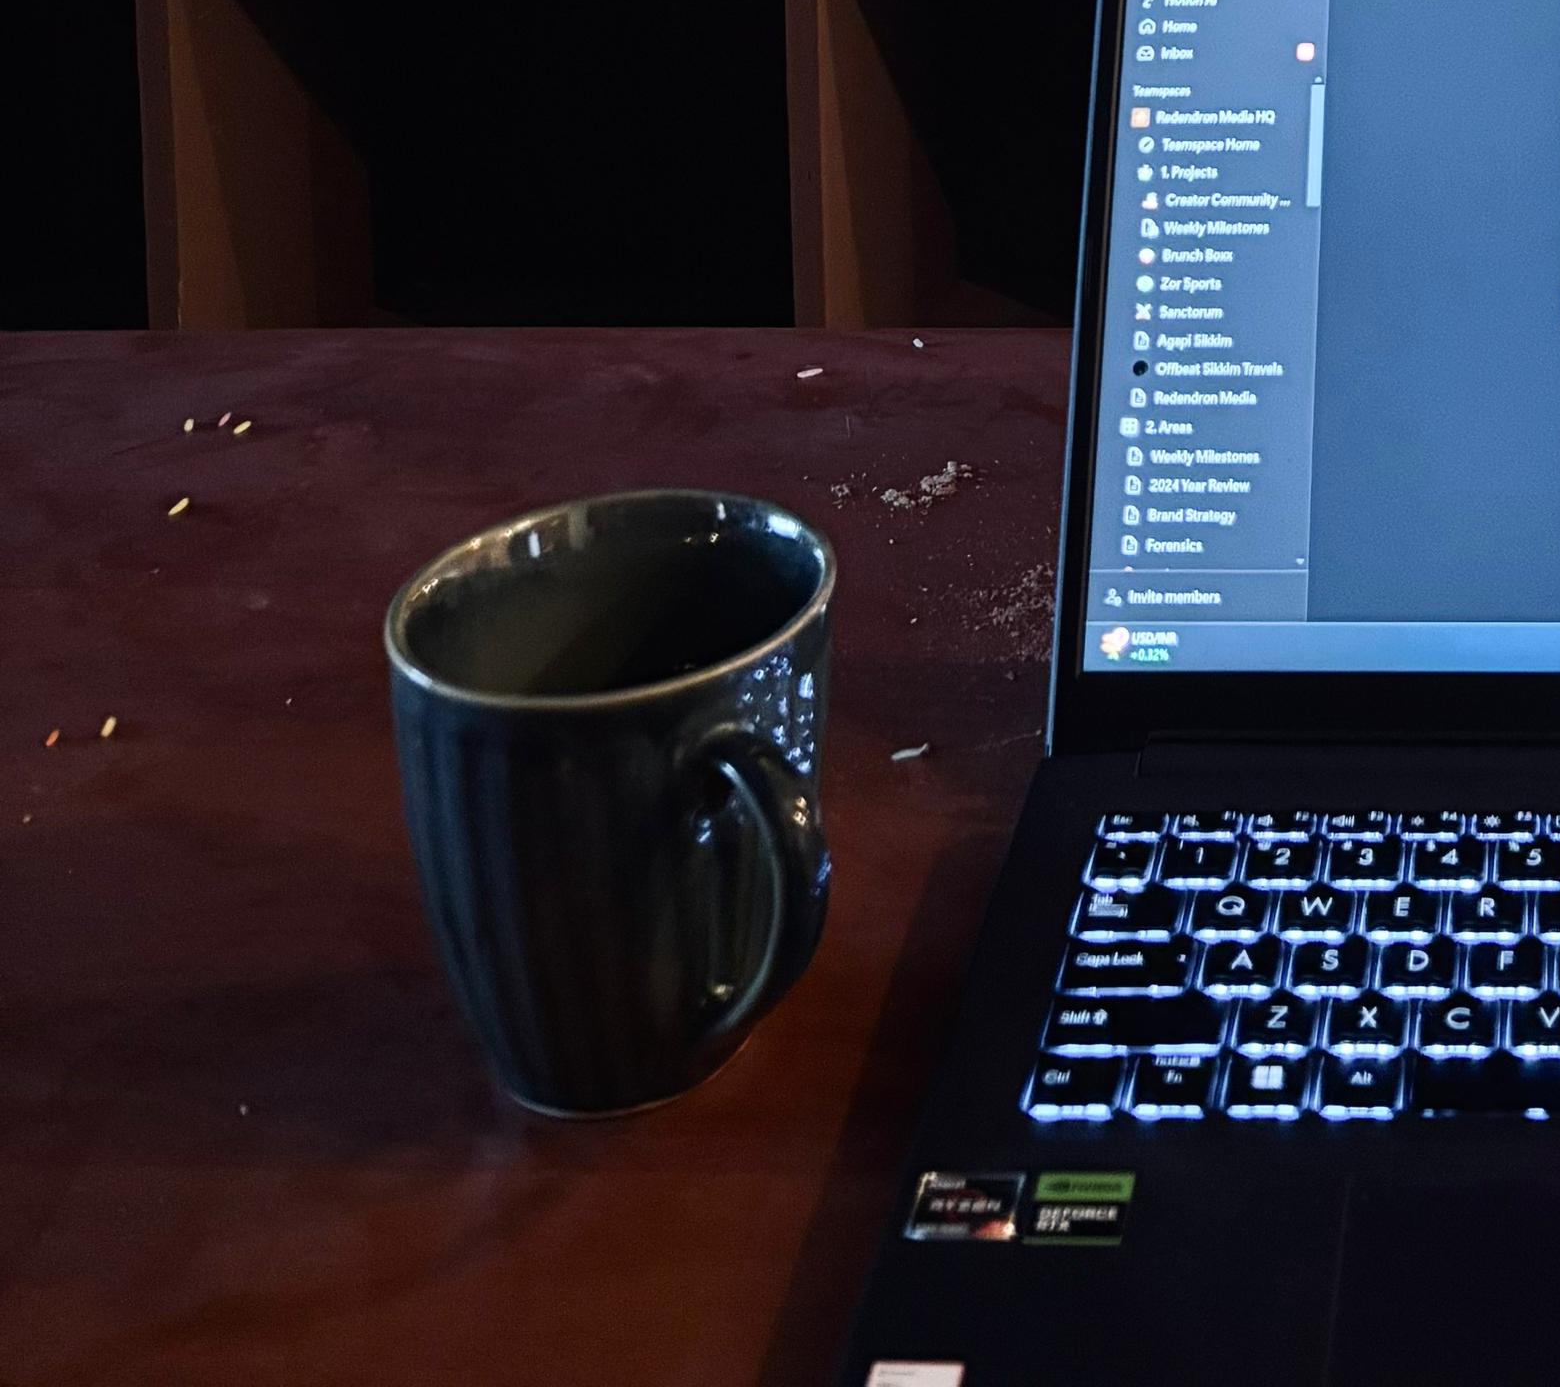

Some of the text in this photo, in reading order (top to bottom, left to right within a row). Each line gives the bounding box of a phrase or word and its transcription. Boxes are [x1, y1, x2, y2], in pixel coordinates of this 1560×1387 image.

[1161, 47, 1193, 60] Inbox
[1149, 479, 1250, 493] 2024 Year Review
[1147, 509, 1236, 526] Brand Strategy
[1145, 539, 1203, 553] Forensics
[1128, 590, 1220, 605] Invite members
[1218, 896, 1332, 916] Q W
[1231, 949, 1339, 970] A S
[1267, 1006, 1377, 1028] Z X
